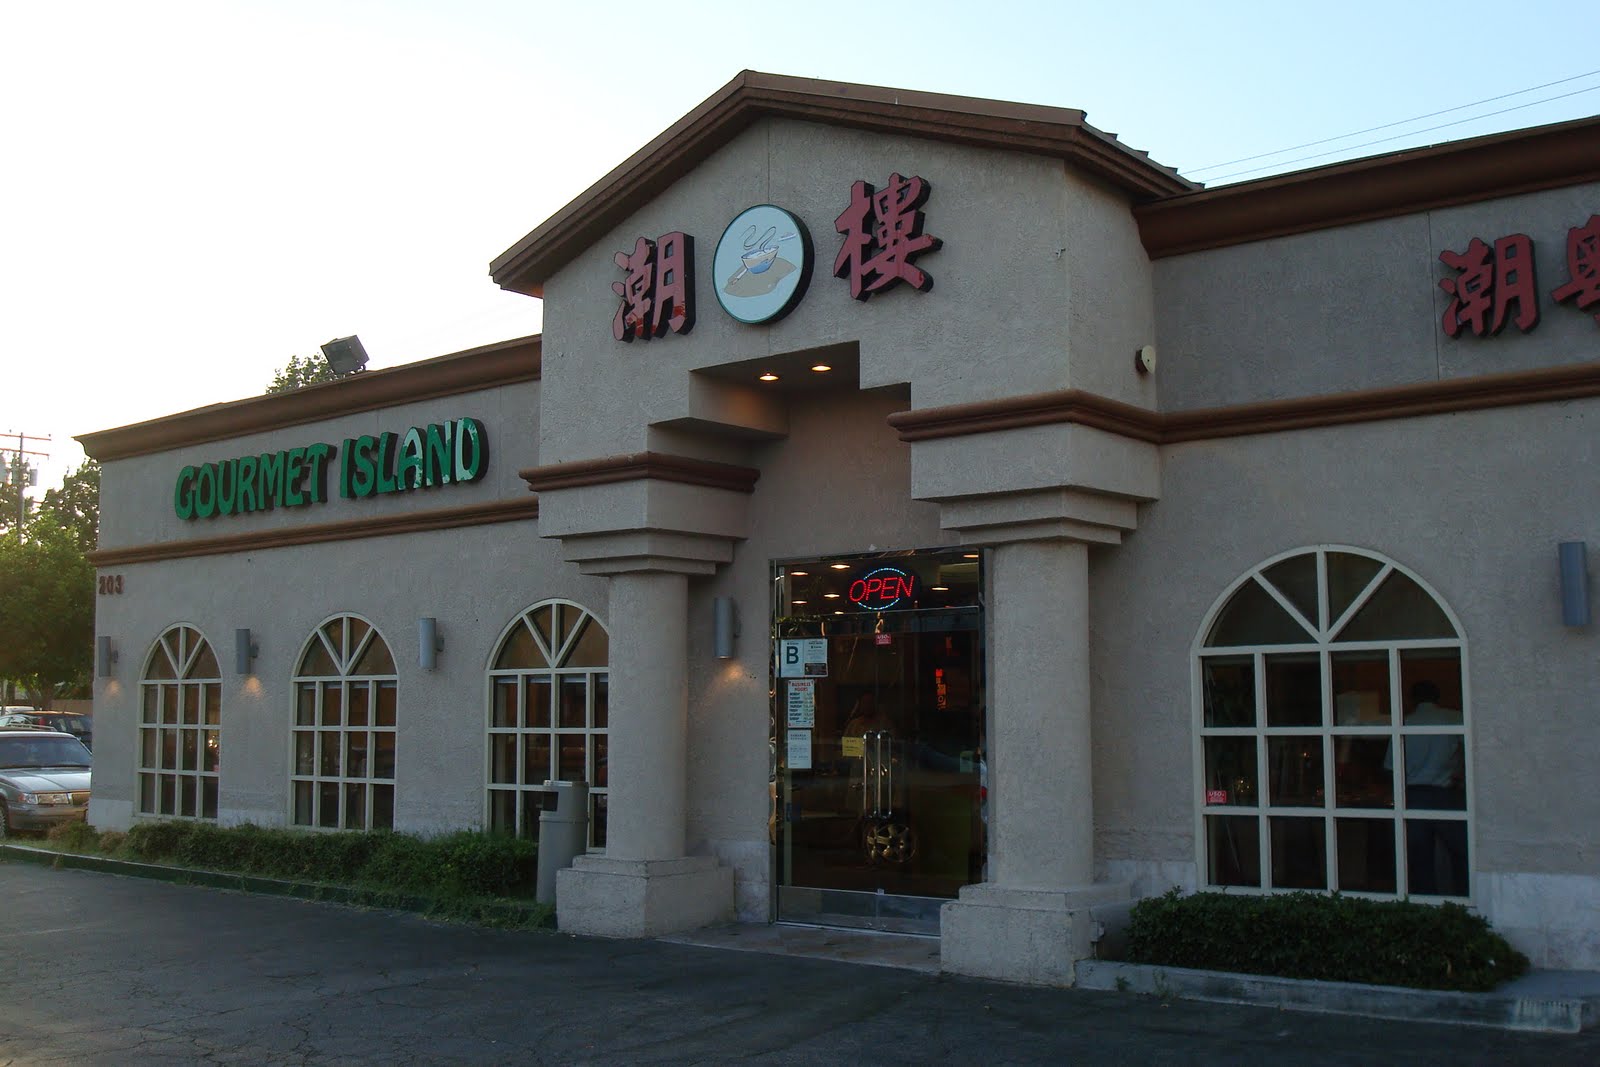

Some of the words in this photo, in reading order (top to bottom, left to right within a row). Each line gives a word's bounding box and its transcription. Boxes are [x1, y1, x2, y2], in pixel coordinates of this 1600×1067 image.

[612, 231, 694, 342] 潮
[833, 172, 941, 302] 樓
[174, 442, 335, 520] GOURMET
[340, 417, 485, 498] ISLAND
[99, 574, 124, 595] 203
[849, 575, 915, 602] OPEN
[786, 645, 799, 665] B
